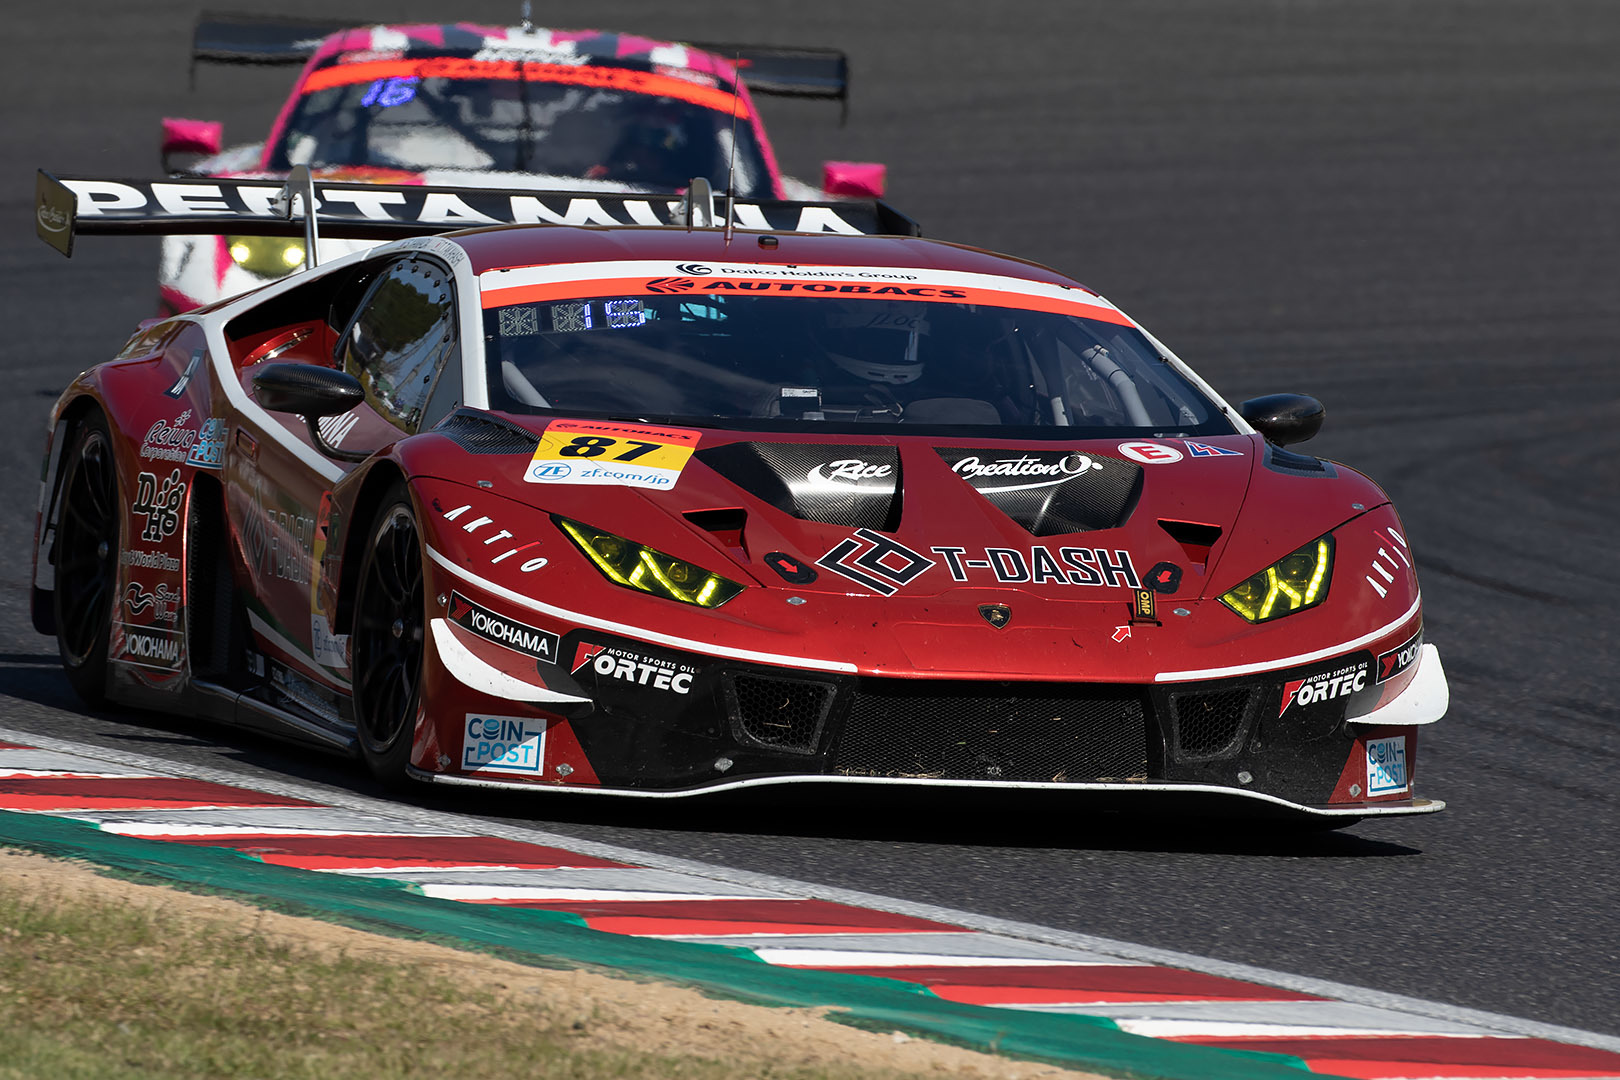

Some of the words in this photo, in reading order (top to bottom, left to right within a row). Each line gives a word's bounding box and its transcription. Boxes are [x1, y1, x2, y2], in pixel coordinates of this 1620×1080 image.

[720, 267, 778, 276] Daiko
[858, 272, 918, 281] Group
[702, 280, 968, 299] AUTOBACS
[583, 425, 693, 440] AUTOBACS
[558, 436, 664, 462] 87
[537, 465, 566, 477] ZF
[580, 468, 670, 485] zf.com/jp
[828, 459, 893, 481] Rice
[930, 545, 1145, 590] T-DASH
[1140, 591, 1151, 615] OMP
[470, 609, 551, 657] YOKOHAMA
[124, 633, 179, 661] YOKOHAMA
[607, 647, 640, 662] MOTOR
[642, 655, 677, 671] SPORTS
[680, 664, 697, 675] OIL
[1306, 672, 1331, 684] MOTOR
[1332, 664, 1357, 678] SPORTS
[1357, 661, 1369, 670] OIL
[477, 741, 534, 764] POST
[1376, 763, 1403, 785] POST
